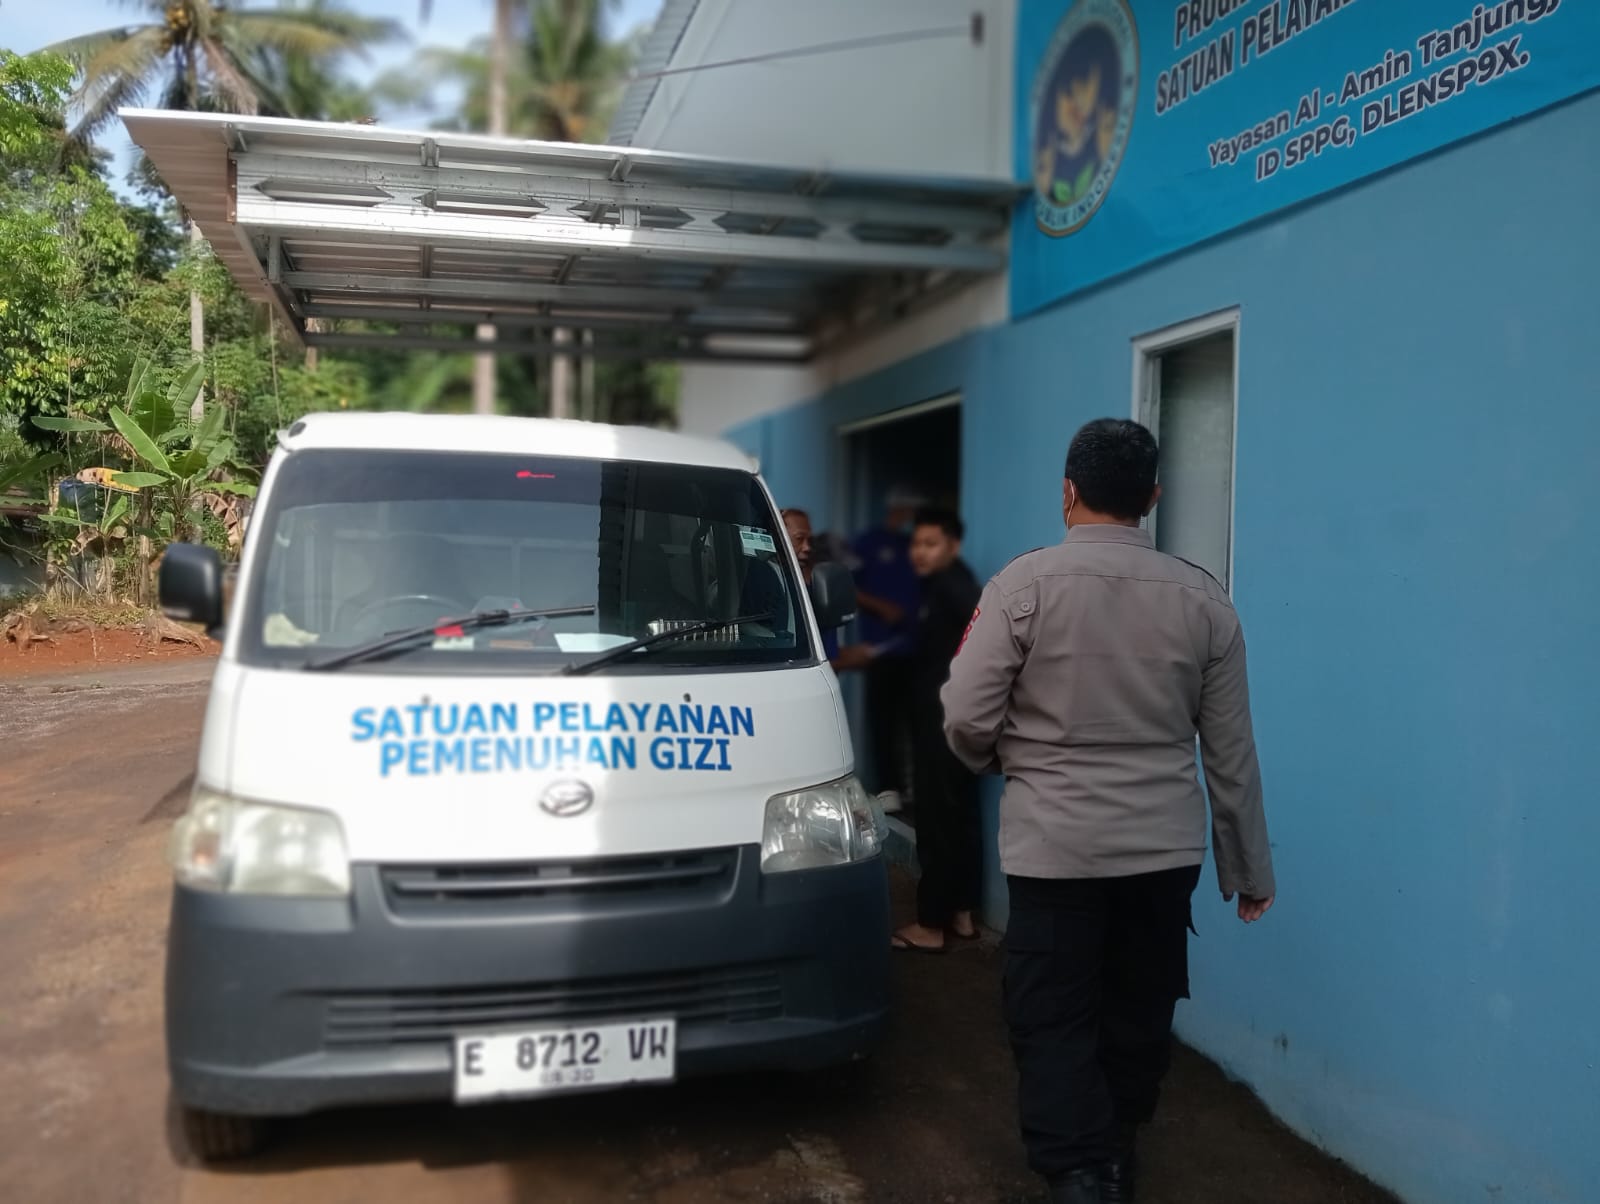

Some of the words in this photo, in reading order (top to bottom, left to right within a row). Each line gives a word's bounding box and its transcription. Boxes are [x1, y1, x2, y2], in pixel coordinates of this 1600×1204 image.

[1156, 30, 1235, 114] SATUAN
[1208, 111, 1290, 167] Yayasan
[1339, 50, 1411, 105] Amin
[1256, 150, 1280, 181] ID
[1284, 115, 1356, 168] SPPG,
[1362, 36, 1530, 134] DLENSP9X.
[350, 703, 517, 741] SATUAN
[533, 702, 756, 737] PELAYANAN
[378, 736, 637, 777] PEMENUHAN
[649, 737, 732, 771] GIZI
[463, 1041, 483, 1076] E
[516, 1031, 601, 1071] 8712
